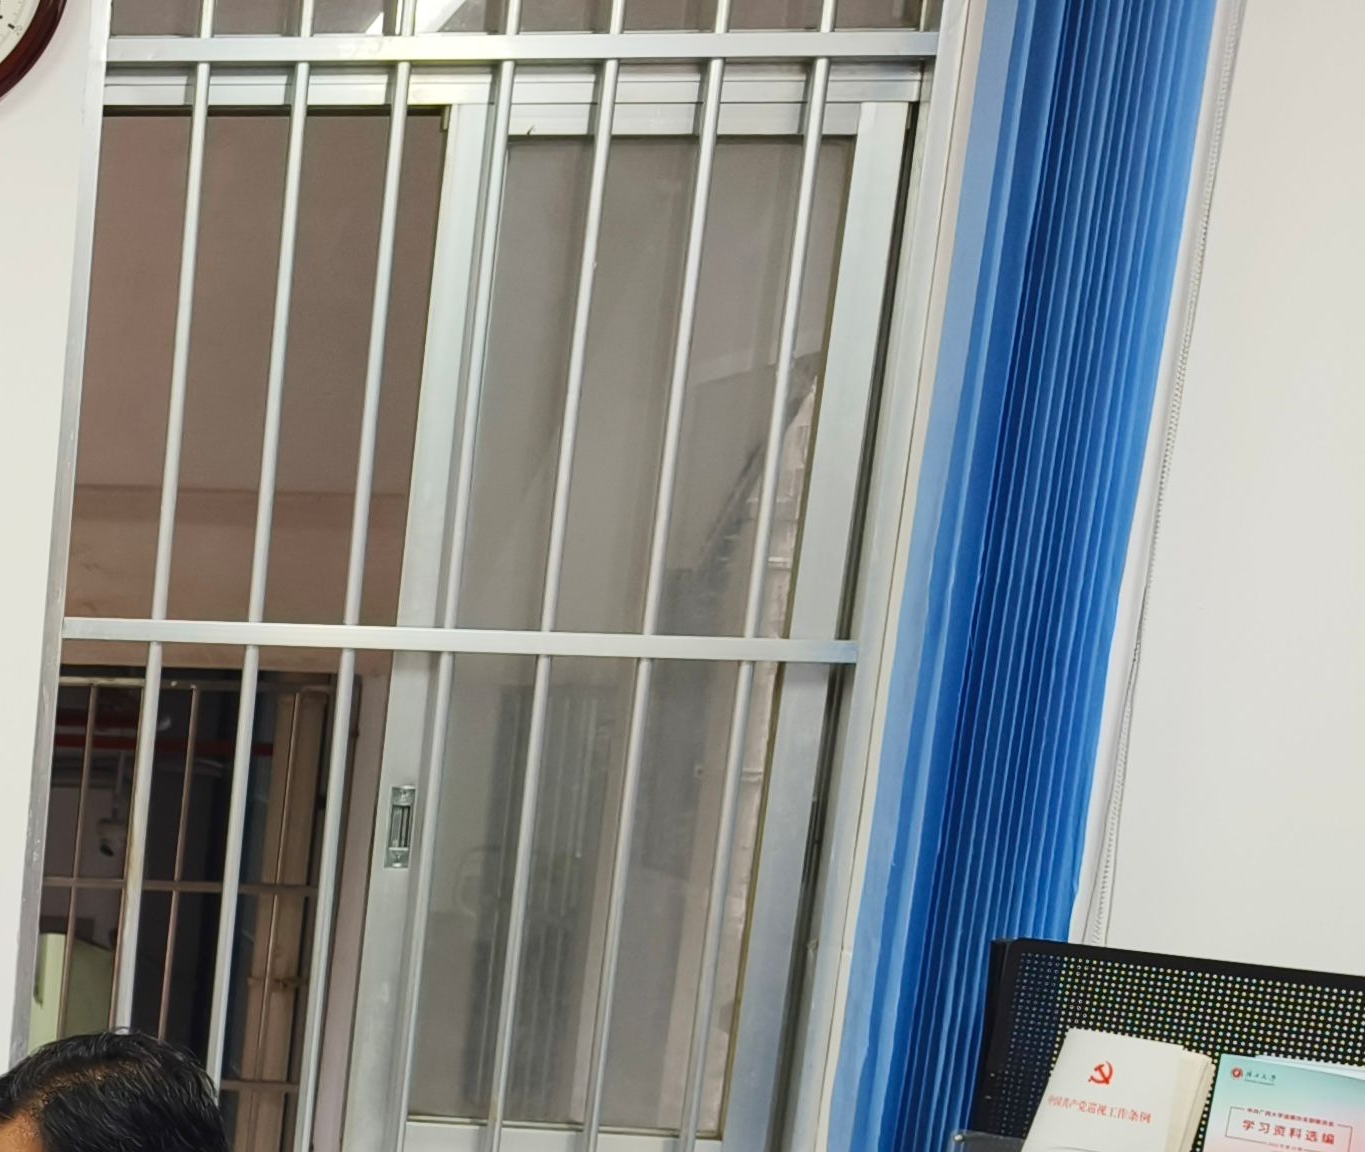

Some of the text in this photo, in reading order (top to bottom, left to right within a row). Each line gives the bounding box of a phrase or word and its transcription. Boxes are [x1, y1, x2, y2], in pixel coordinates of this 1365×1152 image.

[1242, 1119, 1335, 1145] 学习资料选编
